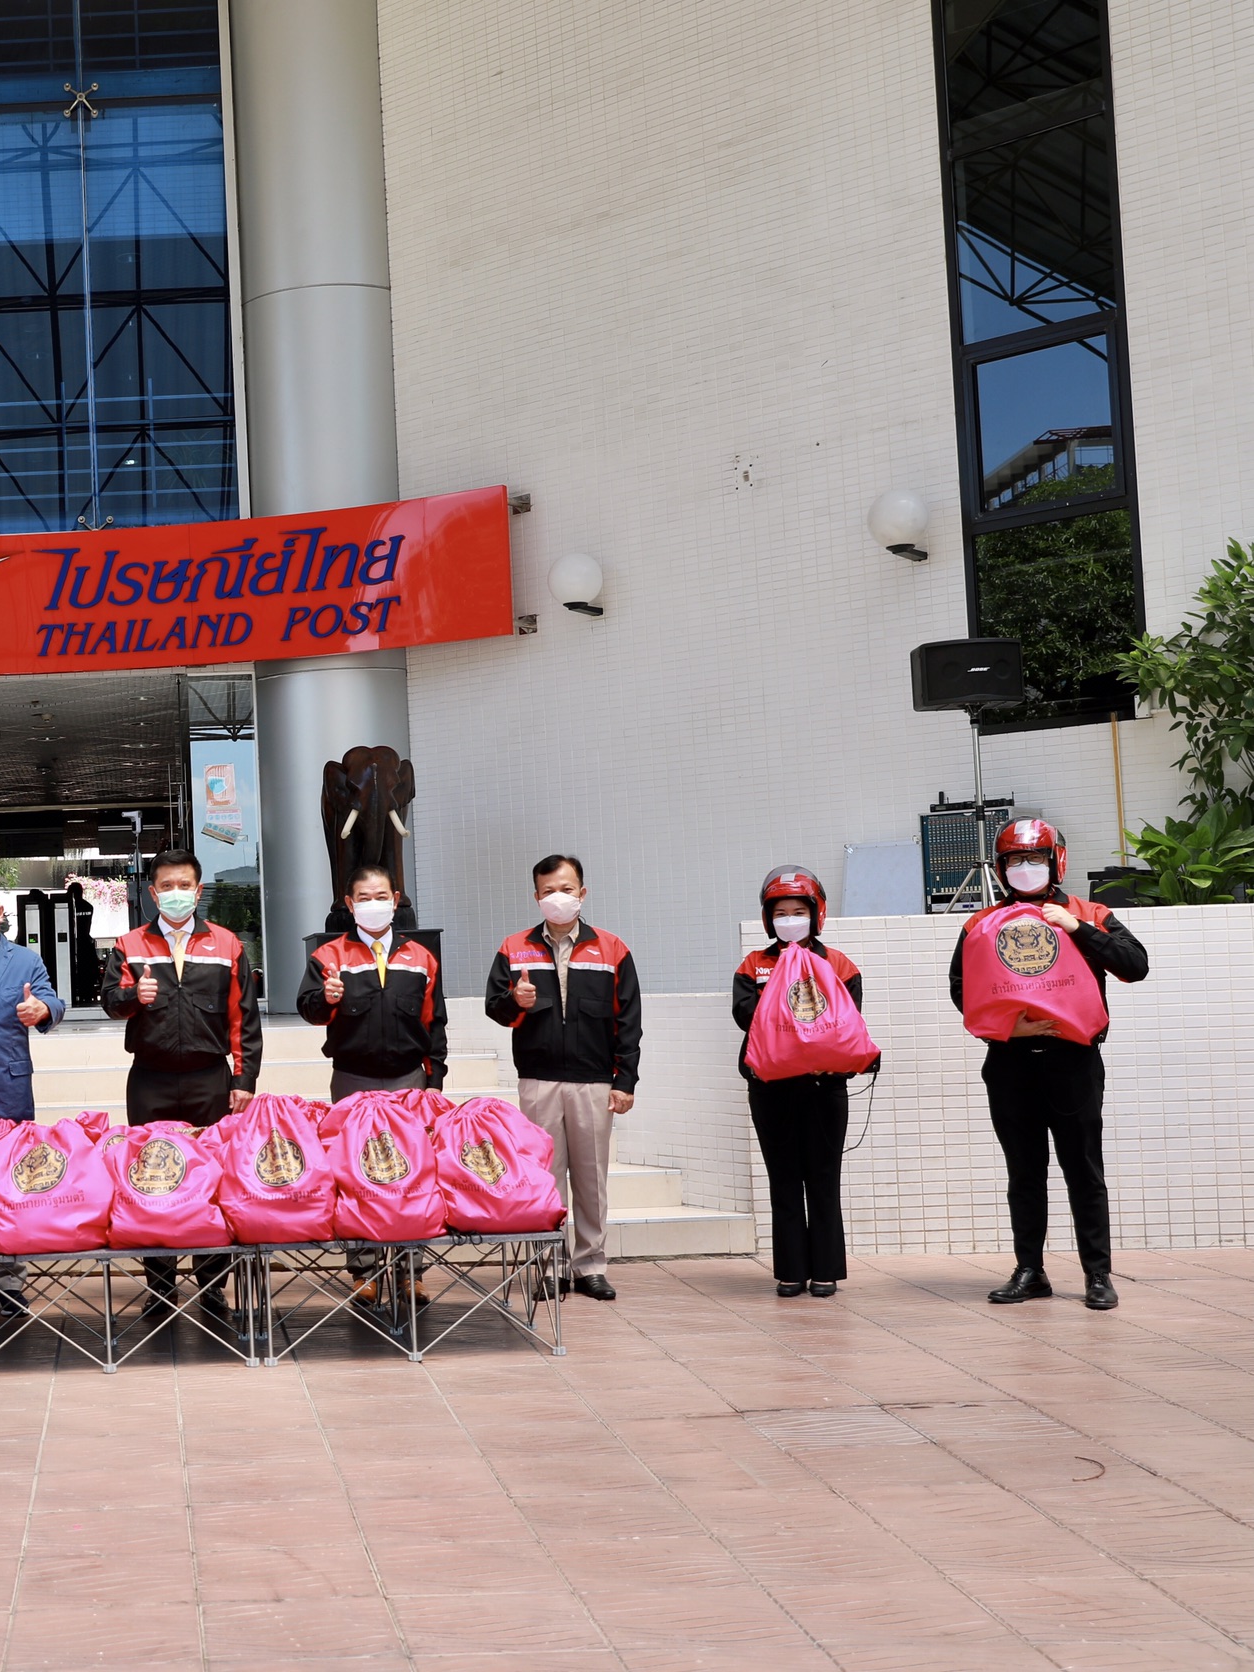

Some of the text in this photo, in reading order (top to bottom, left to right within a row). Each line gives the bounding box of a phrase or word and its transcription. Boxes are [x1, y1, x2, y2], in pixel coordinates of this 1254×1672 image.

[31, 527, 405, 610] ไปรษณีย์ไทย
[37, 595, 401, 657] THAILAND POST
[991, 975, 1075, 995] สำนักนายกรัฐมนตรี
